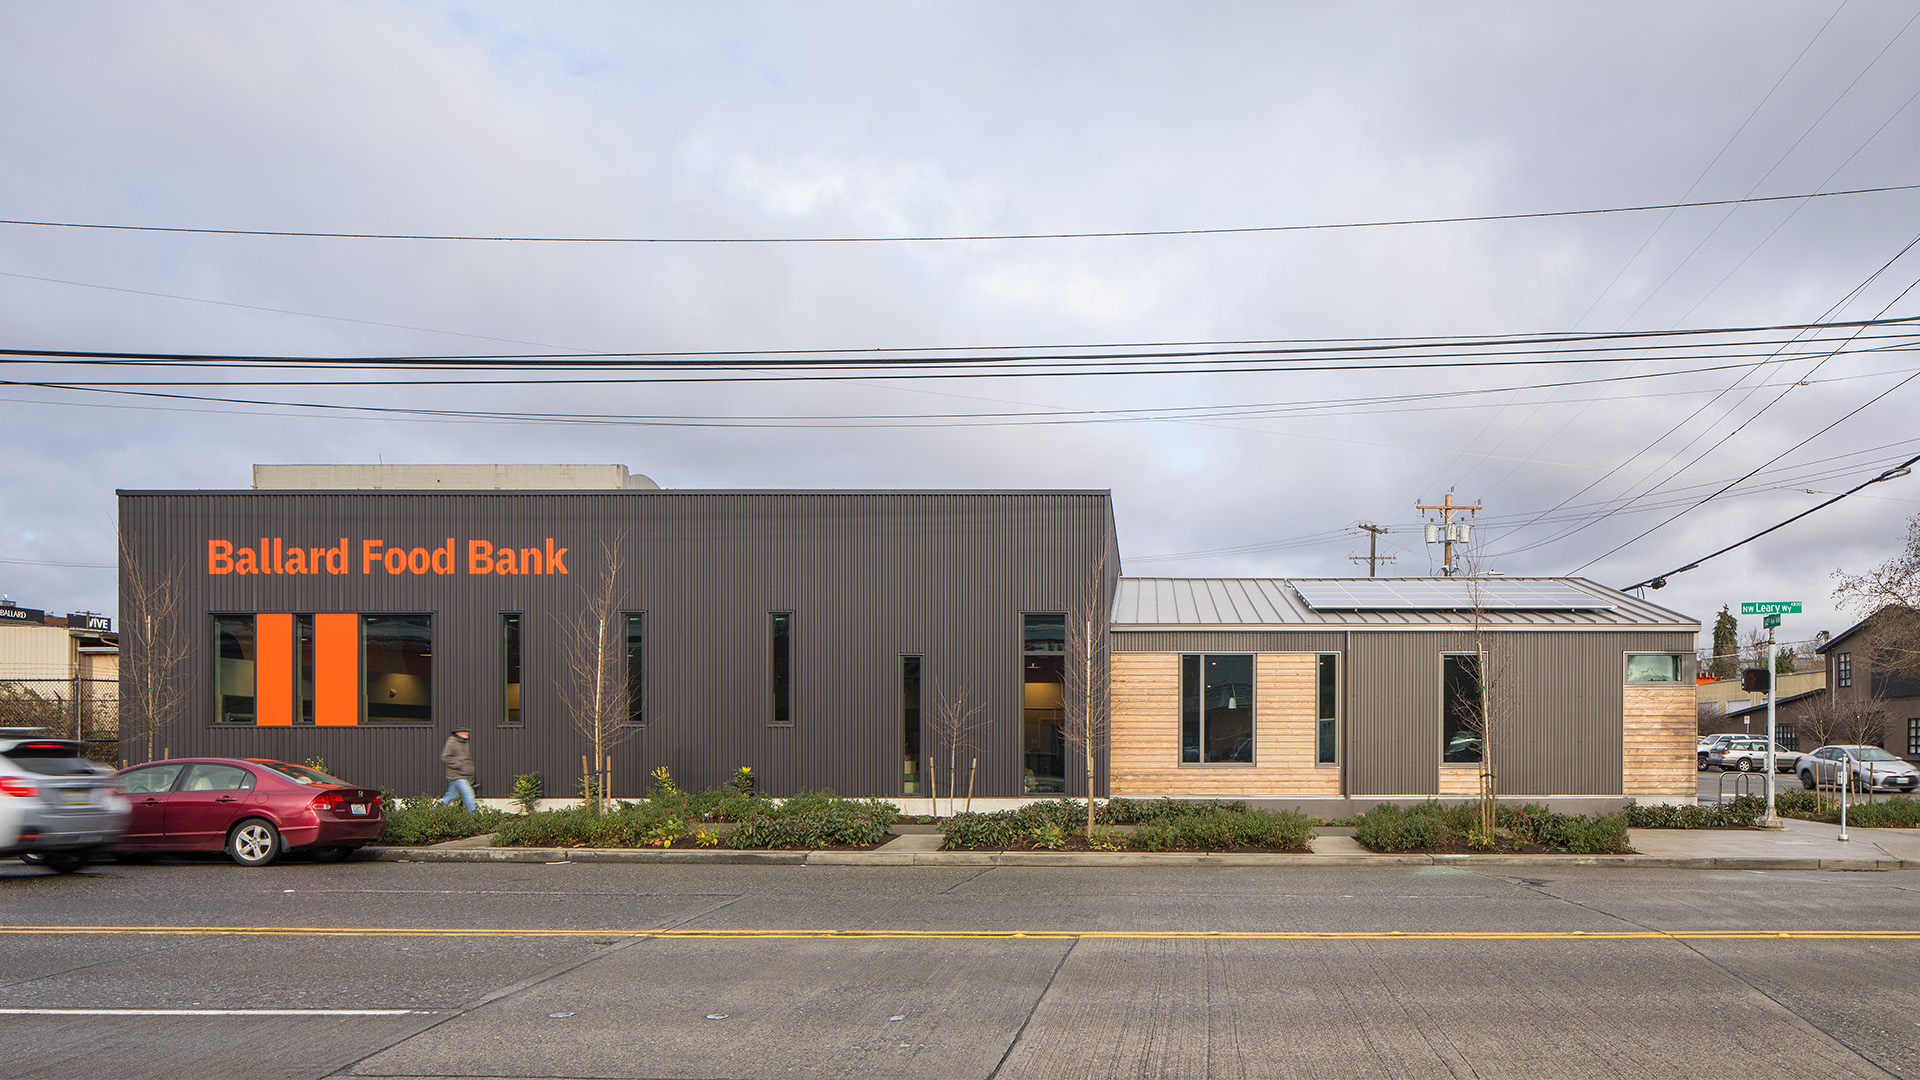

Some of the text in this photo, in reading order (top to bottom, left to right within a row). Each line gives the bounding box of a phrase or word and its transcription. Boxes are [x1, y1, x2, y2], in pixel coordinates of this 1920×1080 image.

[208, 537, 569, 575] Ballard Food Bank
[0, 609, 27, 619] BALLARD
[1742, 605, 1755, 613] NW
[1756, 603, 1780, 614] Leary
[1782, 605, 1792, 613] Wy
